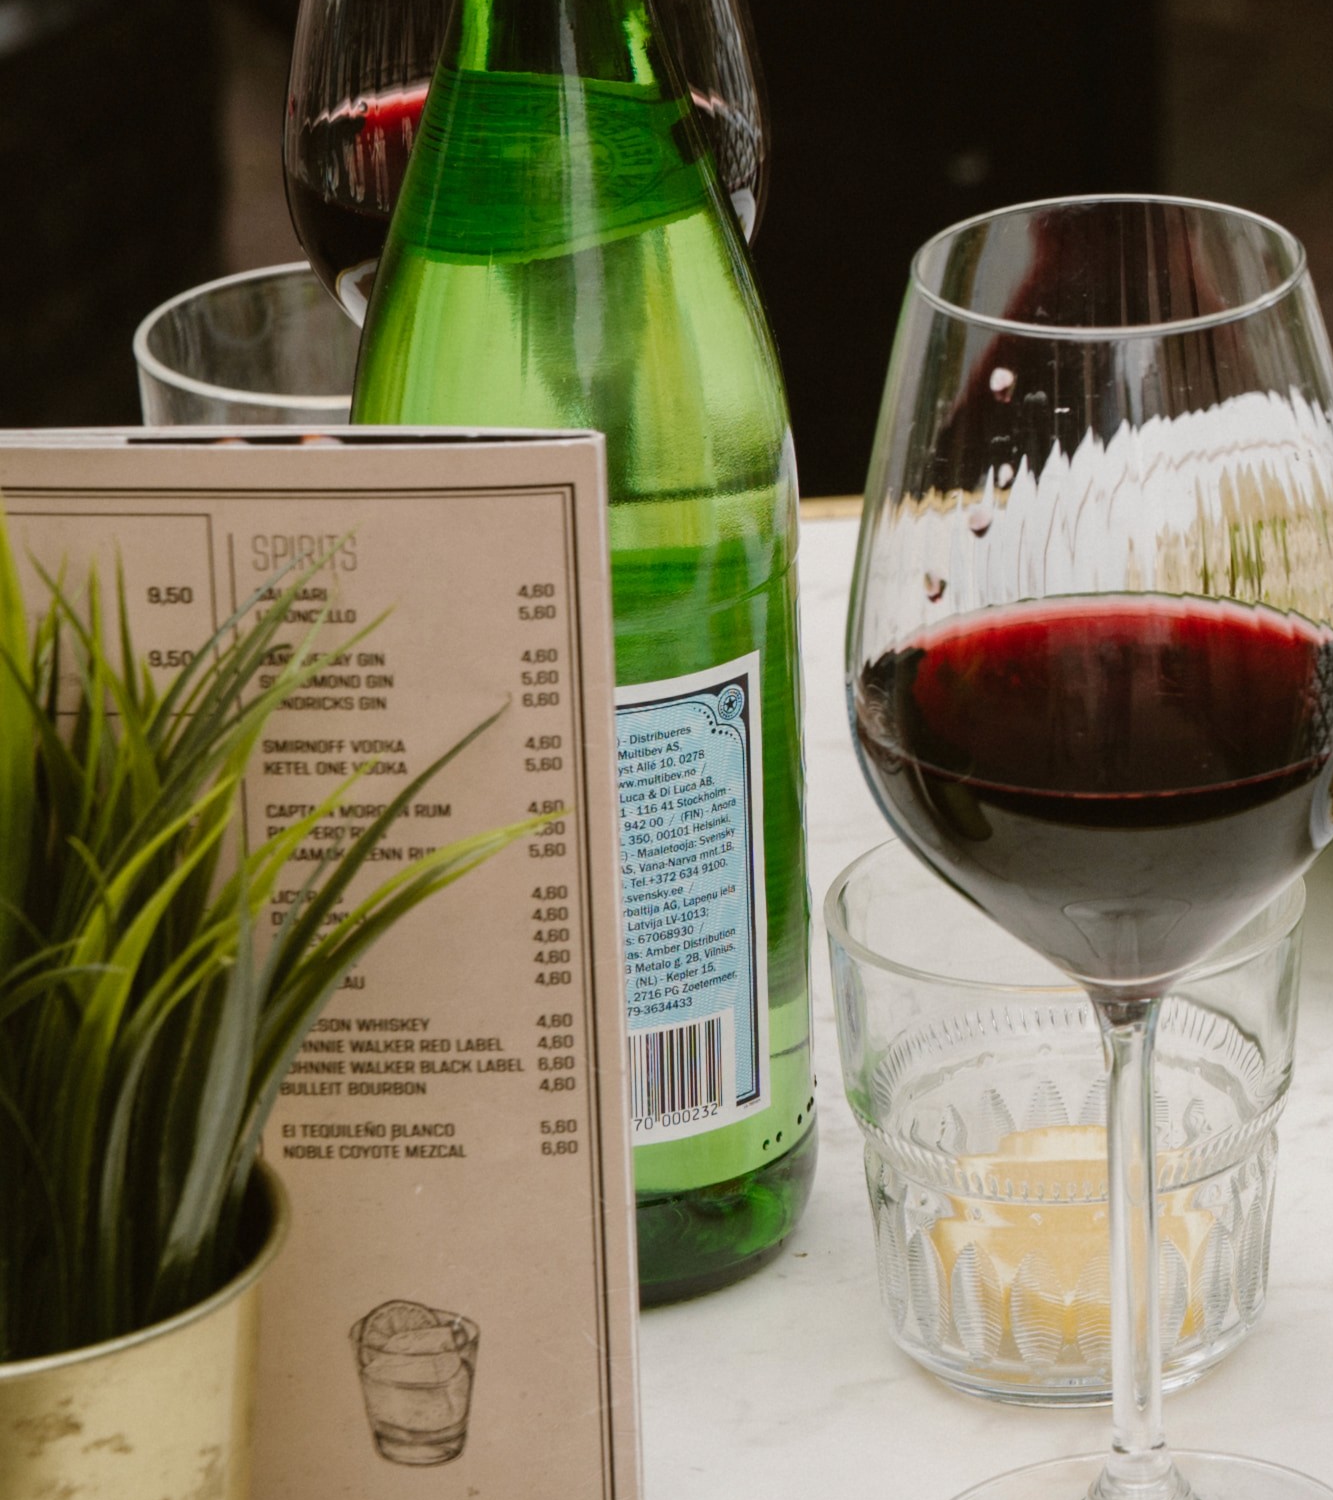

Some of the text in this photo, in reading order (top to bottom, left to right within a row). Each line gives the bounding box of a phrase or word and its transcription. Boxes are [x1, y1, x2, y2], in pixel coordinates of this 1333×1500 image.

[251, 534, 358, 572] SPIRITS
[147, 585, 193, 606] 9,50
[517, 582, 556, 600] 4,60
[518, 603, 557, 621] 5,60
[357, 652, 386, 667] GIN
[521, 647, 559, 664] 4,60
[365, 674, 395, 689] GIN
[521, 669, 560, 687] 5,60
[358, 696, 387, 711] GIN
[262, 734, 563, 754] SMIRNOFF VODKA 4,60
[629, 726, 692, 745] Distribueres
[617, 747, 663, 761] Multibev
[679, 750, 705, 764] 0278
[263, 760, 310, 775] KETEL
[315, 760, 348, 775] ONE
[525, 756, 563, 773] 5,60
[648, 790, 657, 800] &
[673, 782, 697, 796] Luca
[637, 804, 658, 816] 116
[660, 801, 674, 812] 41
[676, 786, 727, 809] Stockholm
[414, 803, 452, 818] RUM
[624, 819, 646, 832] 942
[649, 817, 663, 828] 00
[656, 825, 690, 842] 00101
[699, 827, 736, 845] Svensky
[529, 842, 567, 859] 5,60
[678, 865, 699, 879] 634
[532, 884, 568, 901] 4,60
[532, 906, 569, 922] 4,60
[628, 917, 663, 932] Latvija
[533, 927, 570, 944] 4,60
[638, 924, 694, 945] 67068930
[645, 942, 681, 958] Amber
[683, 927, 736, 950] Distribution
[534, 949, 571, 965] 4,60
[635, 958, 671, 974] Metalo
[535, 970, 572, 987] 4,60
[635, 976, 658, 990] (NL)
[666, 968, 699, 983] Kepler
[634, 988, 662, 1003] 2716
[664, 986, 680, 998] PG
[356, 1017, 431, 1032] WHISKEY
[536, 1012, 574, 1029] 4,60
[349, 1039, 415, 1054] WALKER
[419, 1038, 452, 1053] RED
[455, 1037, 505, 1052] LABEL
[537, 1033, 575, 1050] 4,60
[349, 1060, 416, 1074] WALKER
[420, 1059, 473, 1074] BLACK
[477, 1058, 526, 1073] LABEL
[348, 1081, 427, 1096] BOURBON
[539, 1076, 576, 1093] 4,60
[390, 1122, 456, 1139] BLANCO
[540, 1118, 578, 1135] 5,60
[283, 1144, 335, 1159] NOBLE
[339, 1144, 402, 1159] COYOTE
[405, 1143, 467, 1159] MEZCAL
